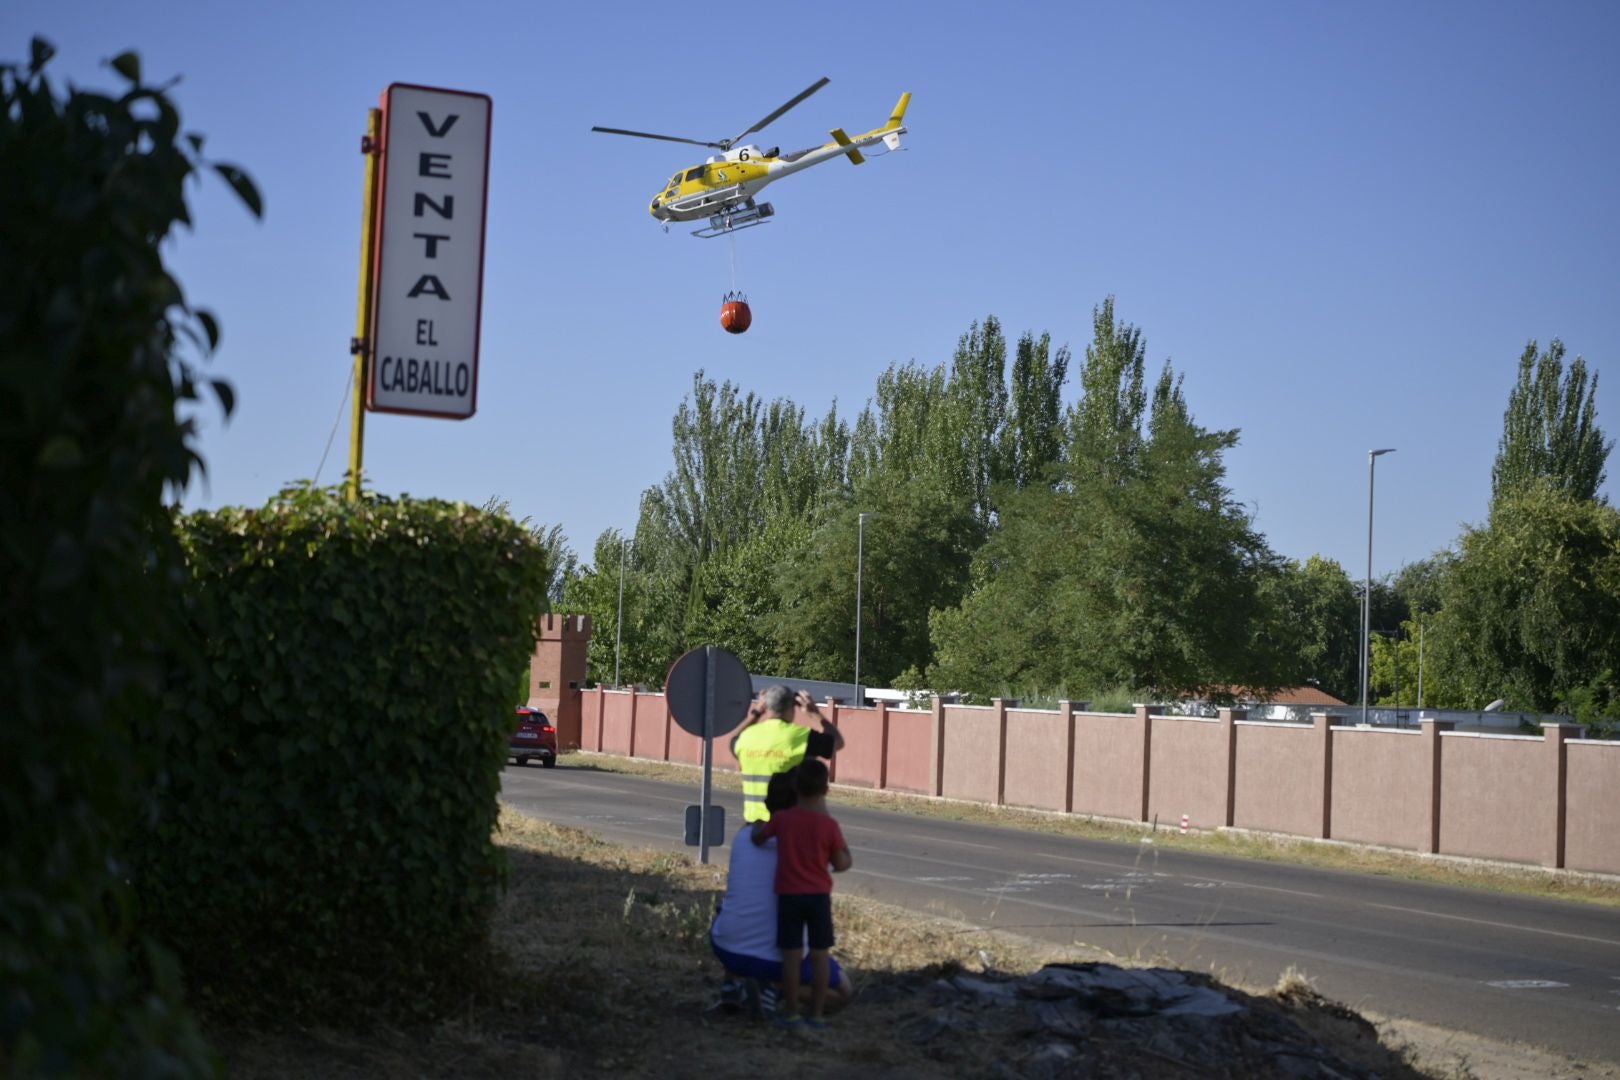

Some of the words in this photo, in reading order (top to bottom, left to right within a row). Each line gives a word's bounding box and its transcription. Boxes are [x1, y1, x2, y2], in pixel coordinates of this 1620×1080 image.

[738, 148, 750, 162] 6
[406, 110, 460, 301] VENTA
[416, 318, 438, 346] EL
[380, 356, 469, 397] CABALLO
